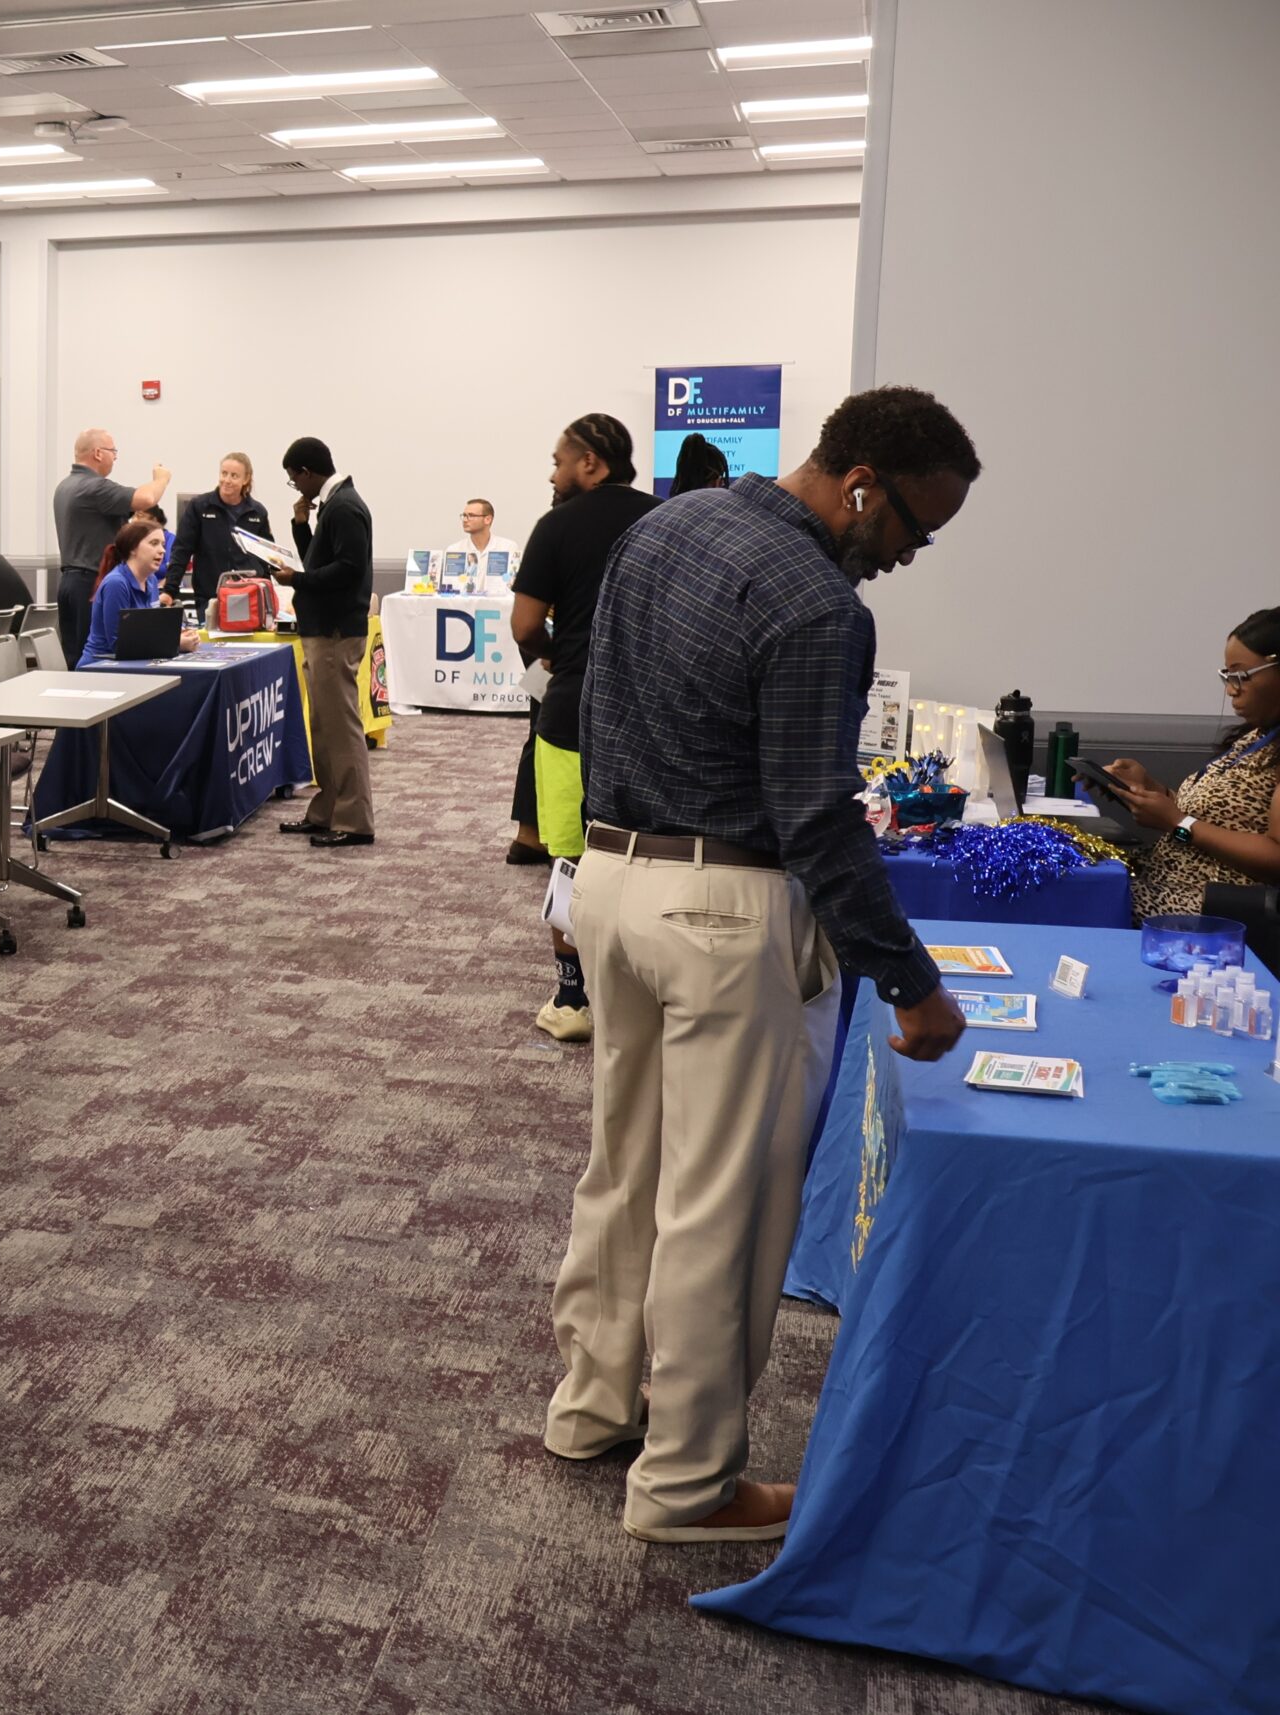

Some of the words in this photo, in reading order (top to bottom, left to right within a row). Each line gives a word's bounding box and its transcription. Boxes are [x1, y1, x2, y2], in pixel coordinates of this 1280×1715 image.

[668, 408, 682, 417] DF
[687, 406, 766, 416] MULTIFAMILY
[435, 669, 460, 684] DF
[473, 693, 486, 702] BY
[226, 676, 285, 753] UPTIME
